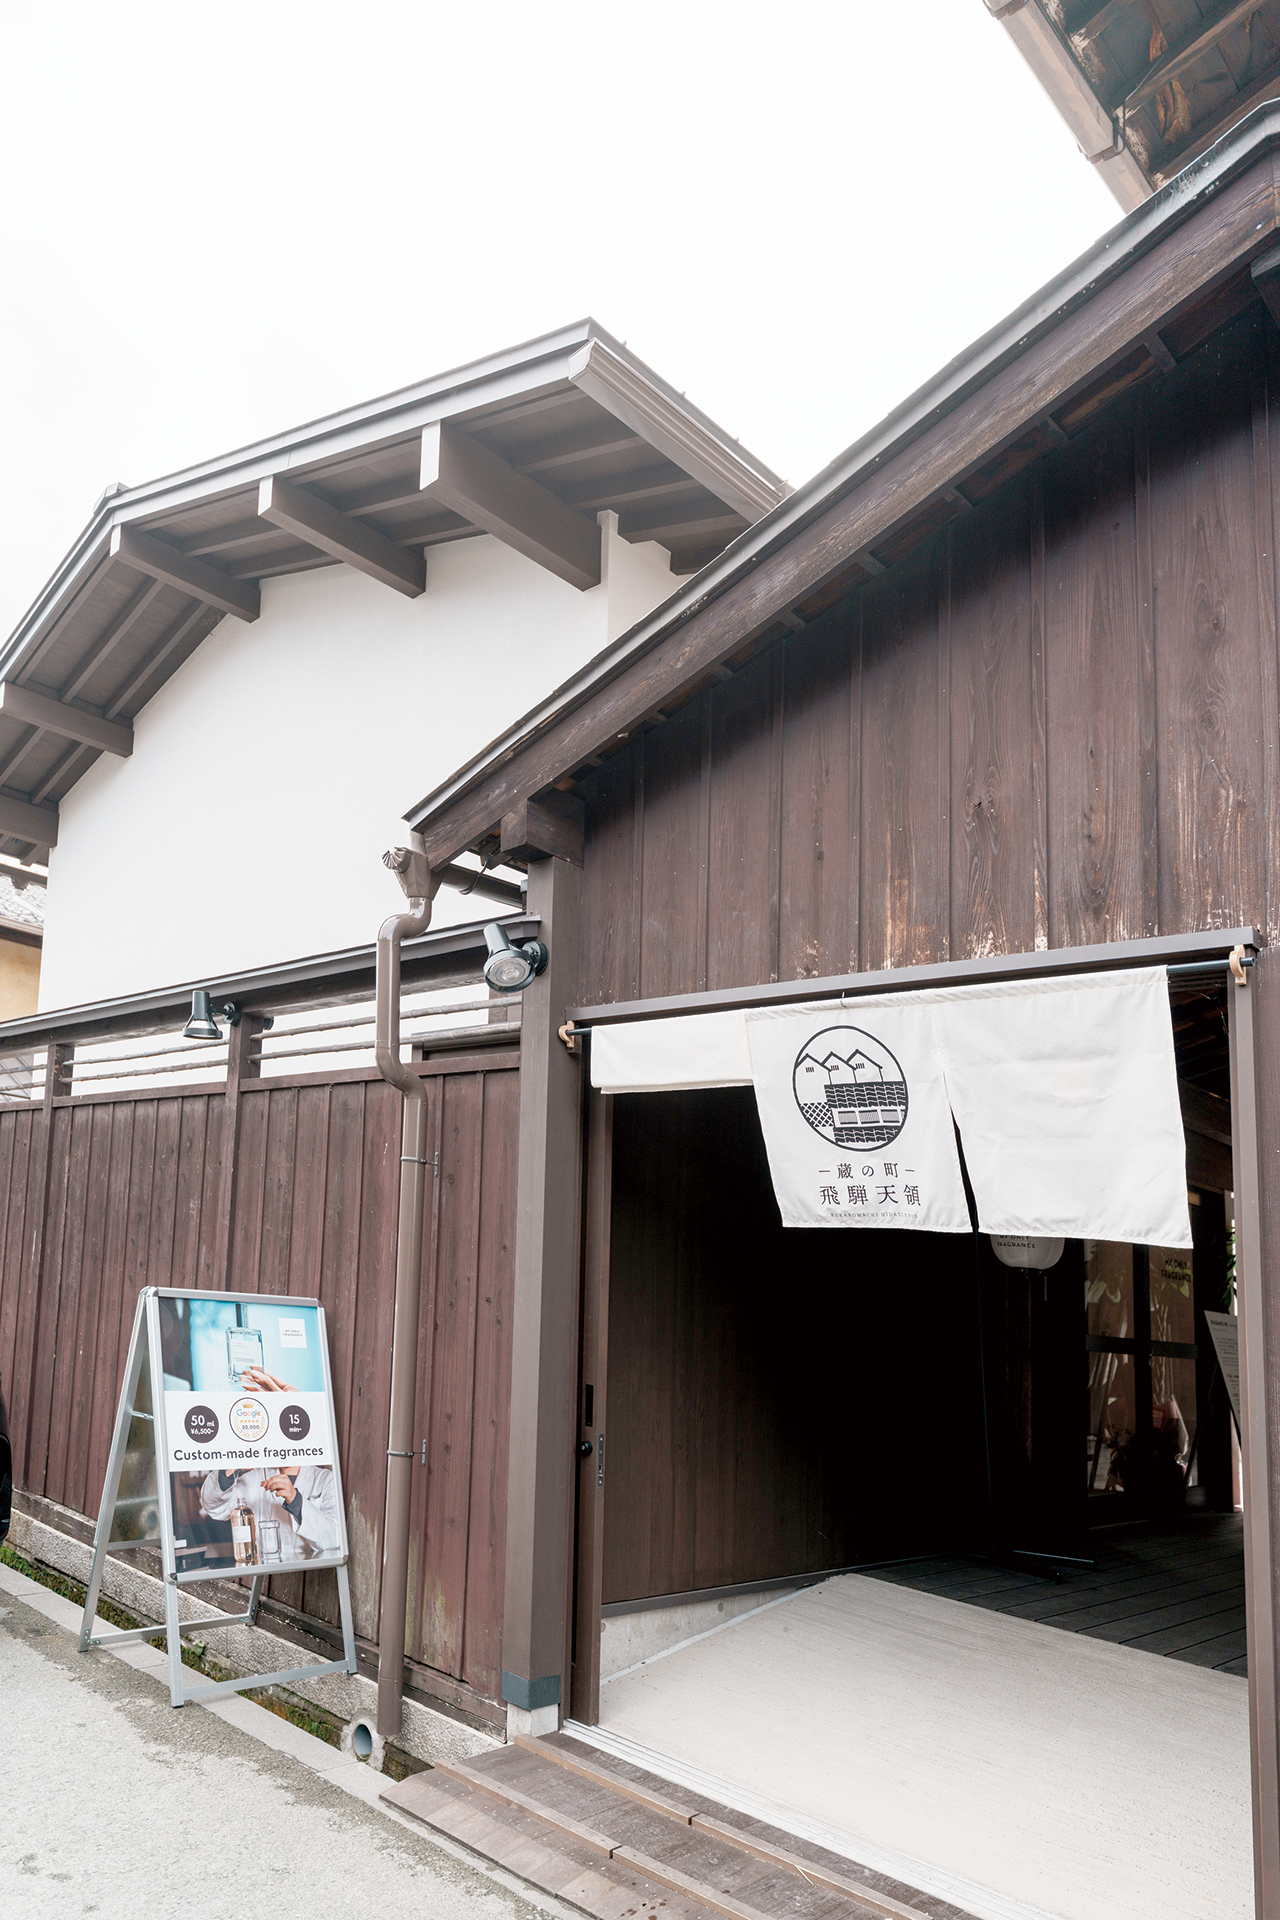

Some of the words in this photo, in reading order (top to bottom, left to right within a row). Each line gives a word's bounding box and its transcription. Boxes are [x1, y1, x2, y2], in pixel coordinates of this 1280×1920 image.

[819, 1184, 921, 1206] 飛騨天領
[996, 1241, 1036, 1249] FRAGRANCE
[236, 1408, 261, 1419] Google
[288, 1413, 301, 1425] 15
[190, 1414, 206, 1426] 50
[173, 1447, 260, 1461] Custom-made
[263, 1446, 324, 1460] fragrances
